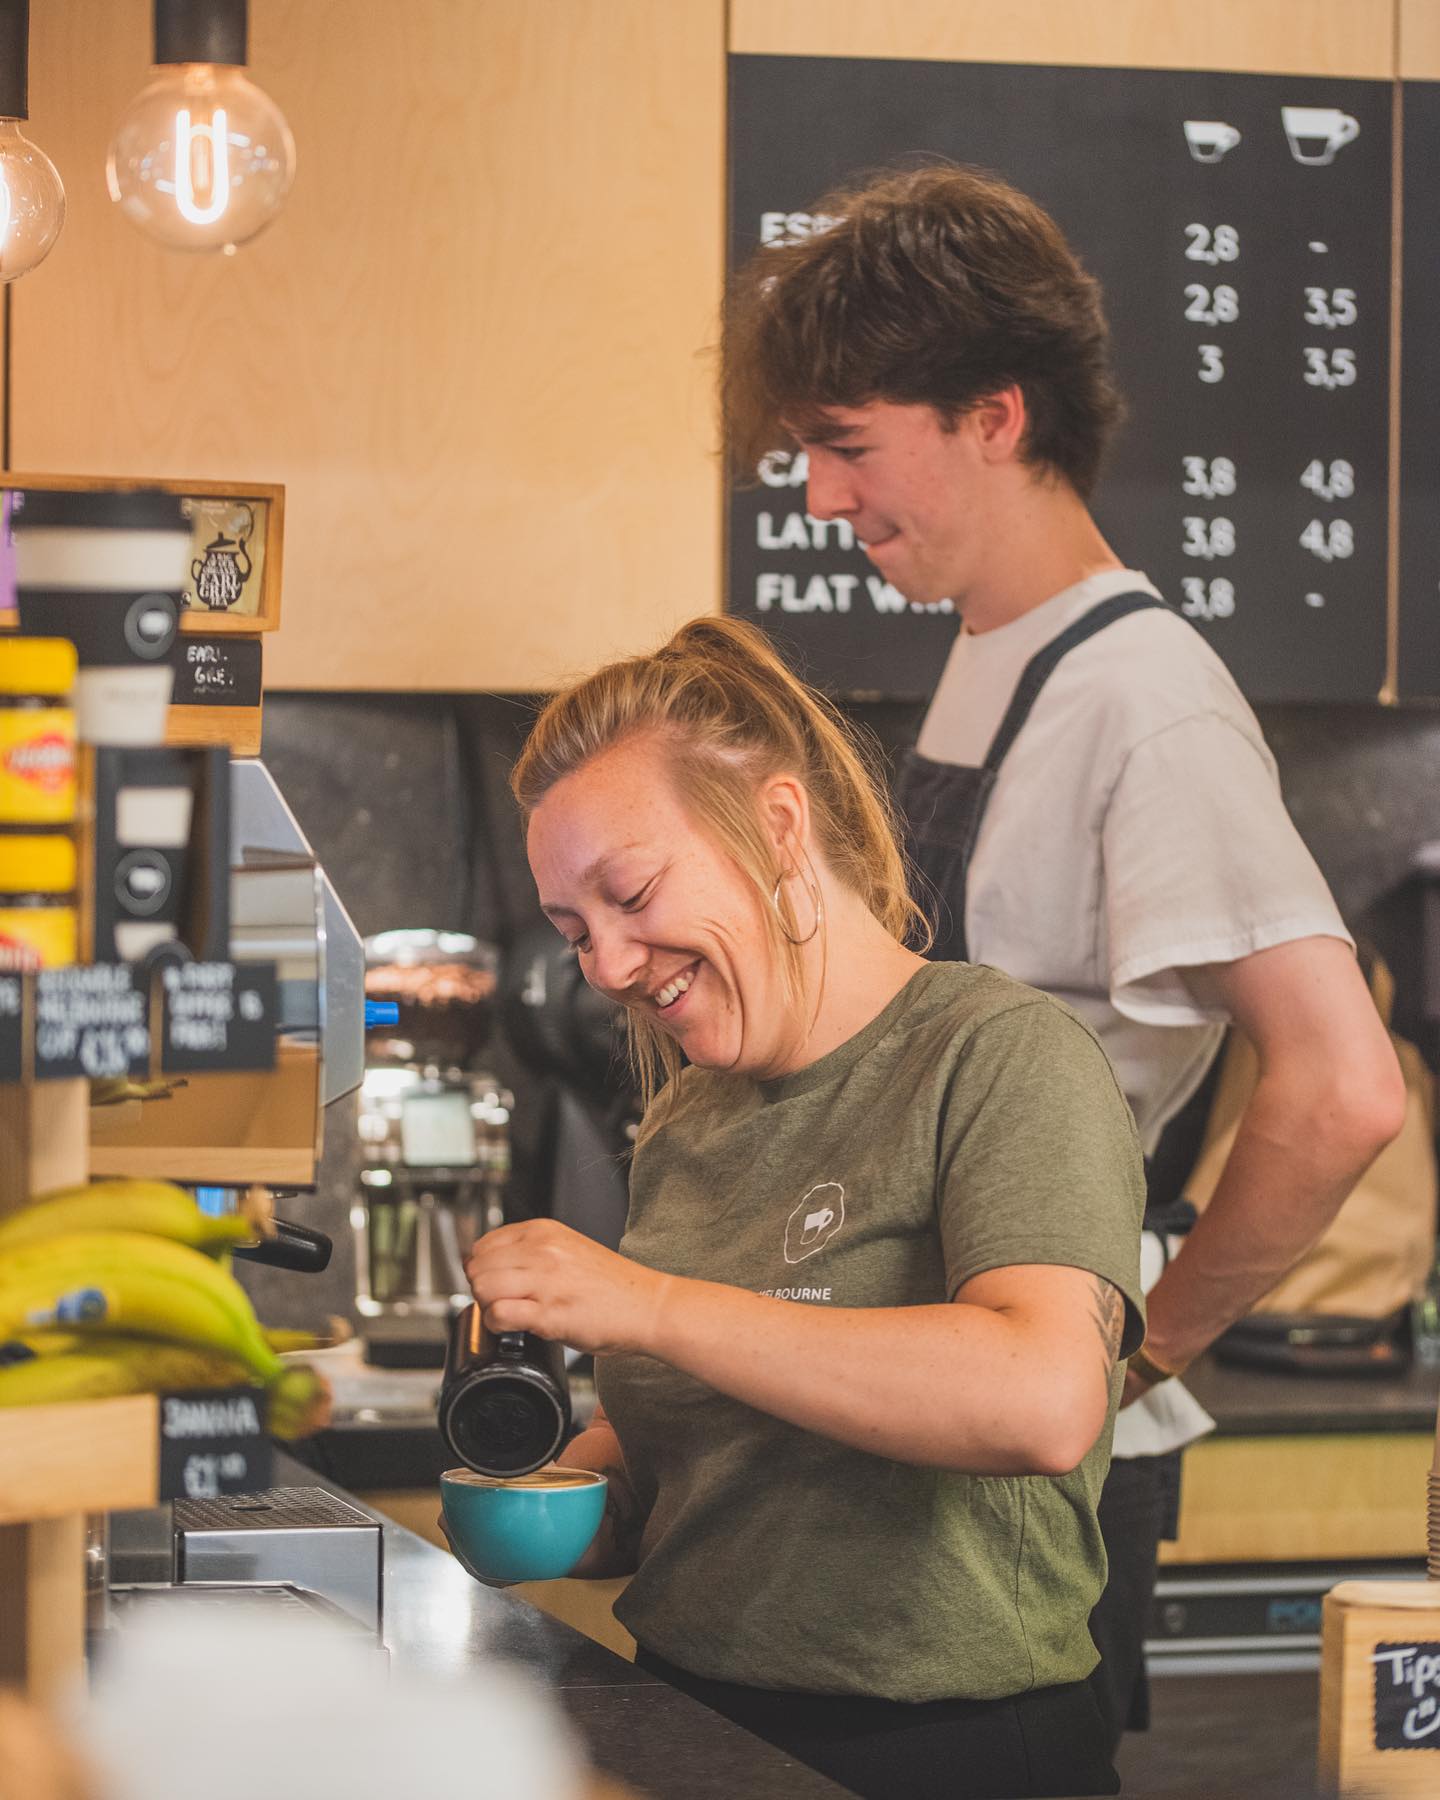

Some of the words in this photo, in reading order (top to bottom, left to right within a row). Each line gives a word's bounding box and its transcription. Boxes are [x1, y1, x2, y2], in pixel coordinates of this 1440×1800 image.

[1199, 345, 1224, 382] 3
[757, 511, 870, 551] LATT
[756, 573, 859, 613] FLAT
